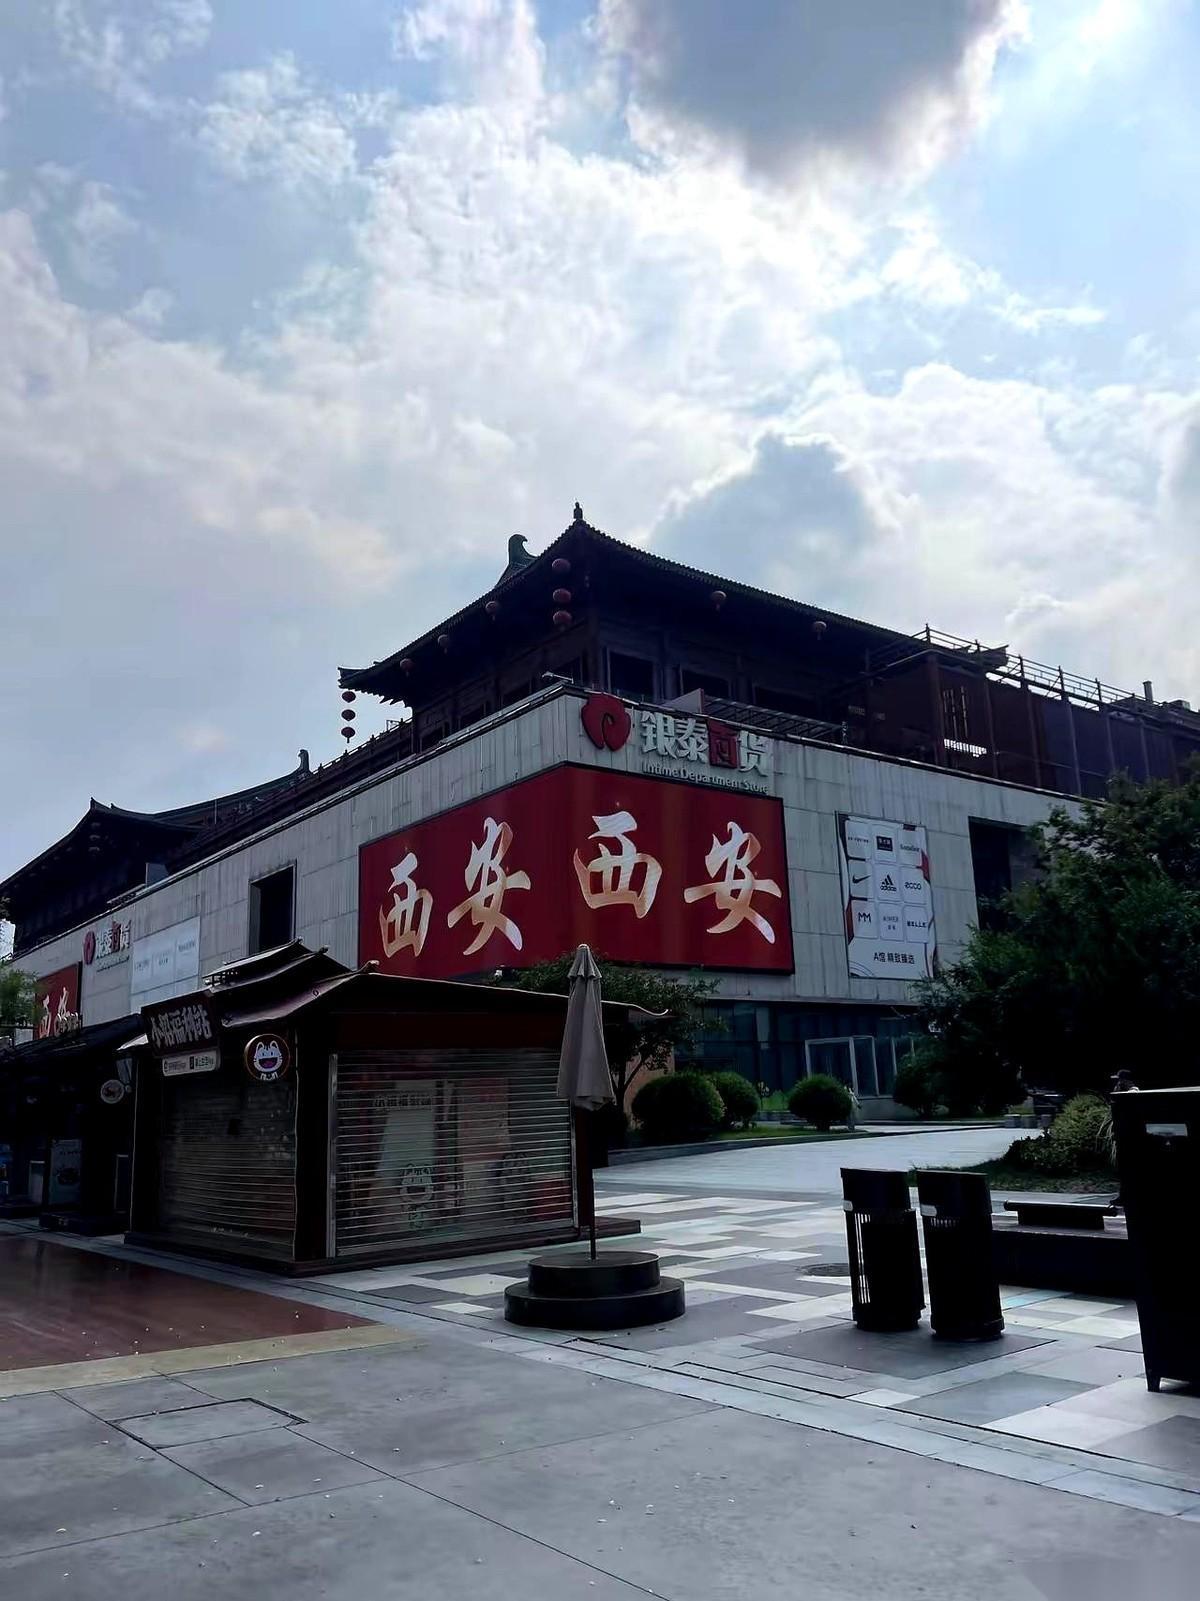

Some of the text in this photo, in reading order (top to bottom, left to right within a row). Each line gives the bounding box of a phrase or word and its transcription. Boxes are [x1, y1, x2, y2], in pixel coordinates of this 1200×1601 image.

[641, 710, 770, 777] 银泰百货
[642, 759, 770, 794] Intime Department Store
[379, 816, 531, 958] 西安
[573, 811, 783, 944] 西安
[880, 884, 897, 892] adidas
